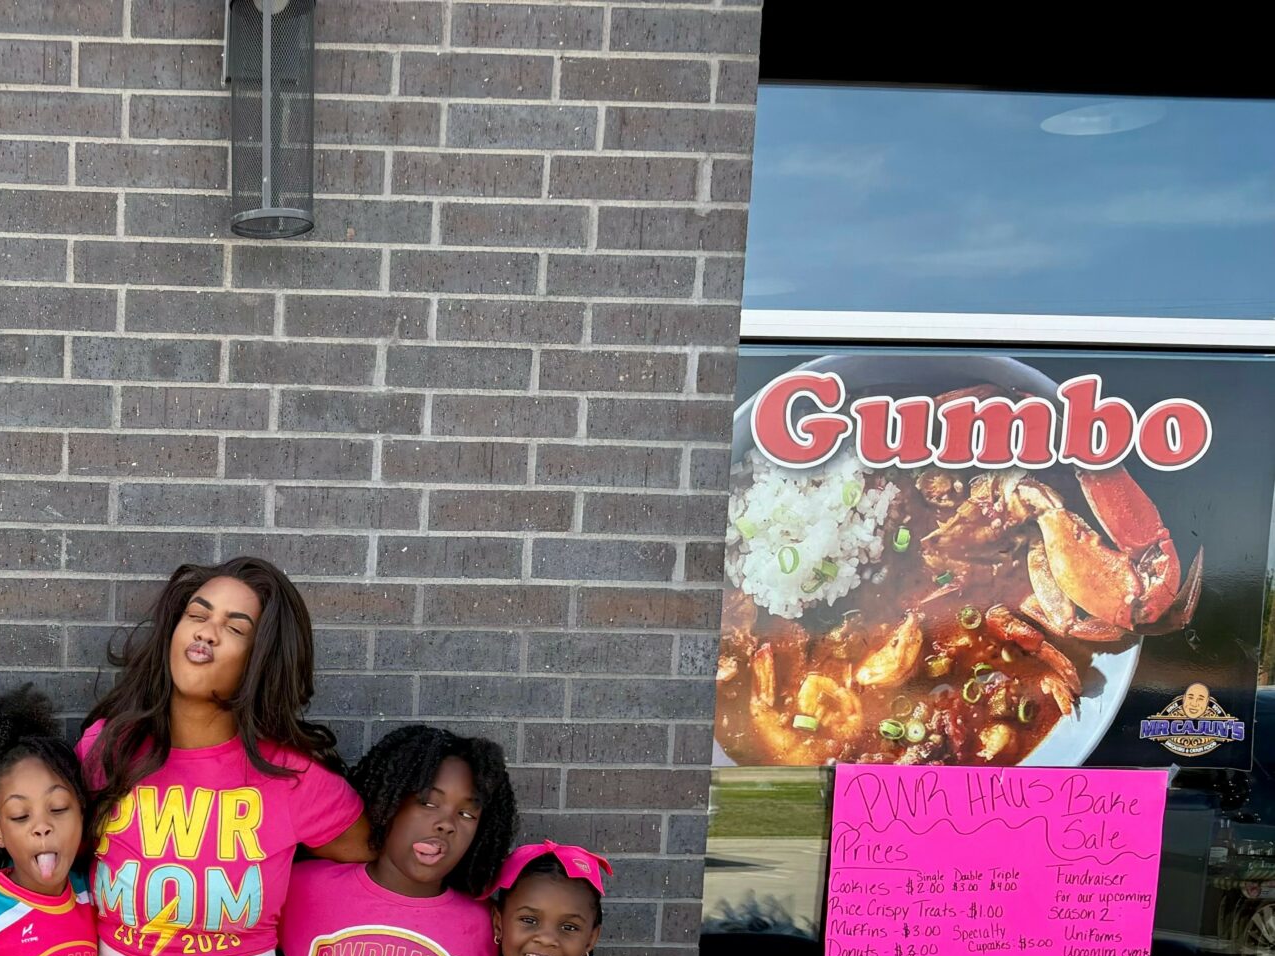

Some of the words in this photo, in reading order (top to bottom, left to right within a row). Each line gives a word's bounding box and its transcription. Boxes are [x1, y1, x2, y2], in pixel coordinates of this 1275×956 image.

[751, 370, 1213, 472] Gumbo
[1139, 720, 1170, 739] MR
[1170, 719, 1245, 741] CAJUN'S
[844, 771, 953, 824] PWR
[967, 772, 1055, 816] HAUS
[1060, 774, 1141, 817] Bake
[96, 785, 266, 861] PWR
[1062, 818, 1127, 850] Sale
[834, 829, 909, 864] Prices
[830, 871, 891, 896] Cookies
[905, 877, 945, 896] $2.00
[951, 881, 979, 892] $3.00
[988, 880, 1018, 892] $4.00
[916, 871, 945, 884] Single
[953, 868, 983, 882] Double
[988, 867, 1021, 881] Triple
[1046, 864, 1130, 886] Fundraiser
[94, 859, 264, 933] MOM
[1055, 889, 1071, 903] for
[1077, 894, 1094, 904] our
[1098, 892, 1152, 909] upcoming
[828, 896, 865, 917] Rice
[866, 898, 911, 921] Crispy
[912, 899, 957, 918] Treats
[966, 901, 1005, 920] $1.00
[829, 919, 888, 939] Muffins
[901, 922, 942, 939] $3.00
[952, 922, 1006, 942] Specialty
[1063, 925, 1123, 943] Uniforms
[1018, 934, 1054, 951] $5.00
